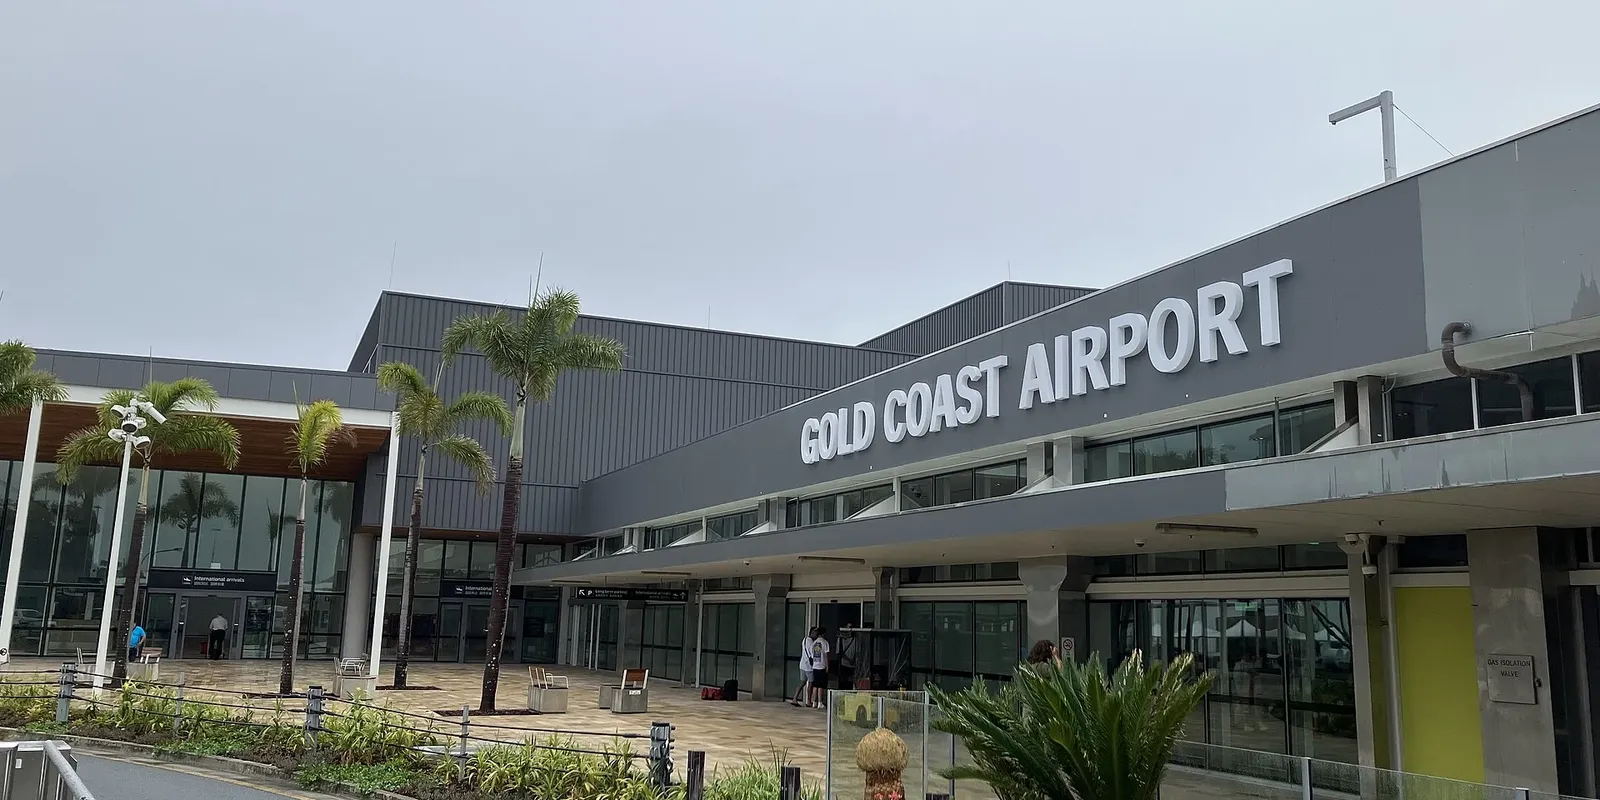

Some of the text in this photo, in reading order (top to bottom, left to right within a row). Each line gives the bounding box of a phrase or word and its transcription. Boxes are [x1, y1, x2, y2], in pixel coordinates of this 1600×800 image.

[801, 257, 1294, 464] GOLD COAST AIRPORT
[1488, 658, 1531, 667] GAS ISOLATION
[1501, 670, 1519, 678] VALVE
